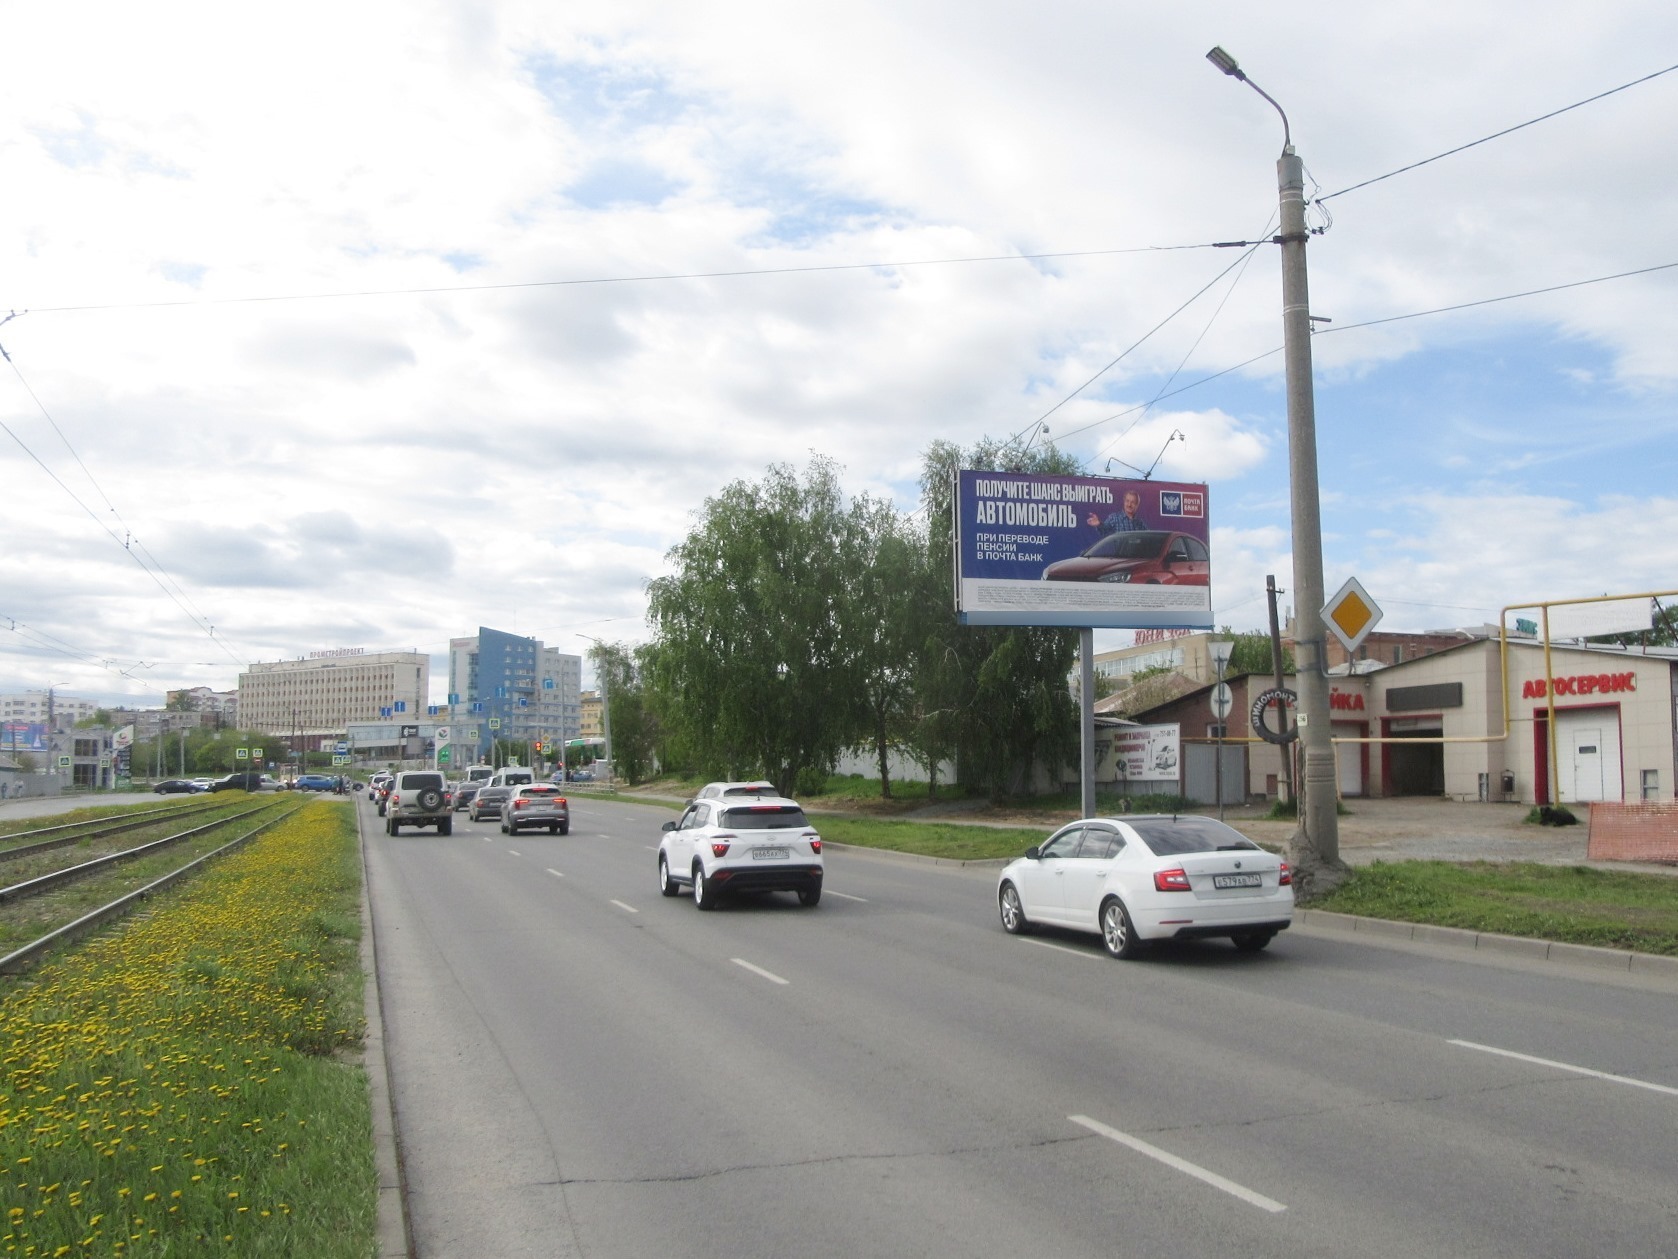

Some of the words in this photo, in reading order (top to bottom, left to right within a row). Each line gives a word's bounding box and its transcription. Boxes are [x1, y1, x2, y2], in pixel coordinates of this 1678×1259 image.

[976, 479, 1030, 499] ПОЛУЧИТЕ
[1031, 483, 1061, 501] ШАНС
[1062, 484, 1114, 504] ВЫИГРАТЬ
[976, 501, 1077, 528] АВТОМОБИЛЬ
[976, 533, 997, 543] ПРИ
[999, 534, 1049, 545] ПЕРЕВОДЕ
[976, 542, 1017, 552] ПЕНСИИ
[977, 551, 984, 560] В
[986, 552, 1017, 561] ПОЧТА
[1018, 553, 1043, 562] БАНК
